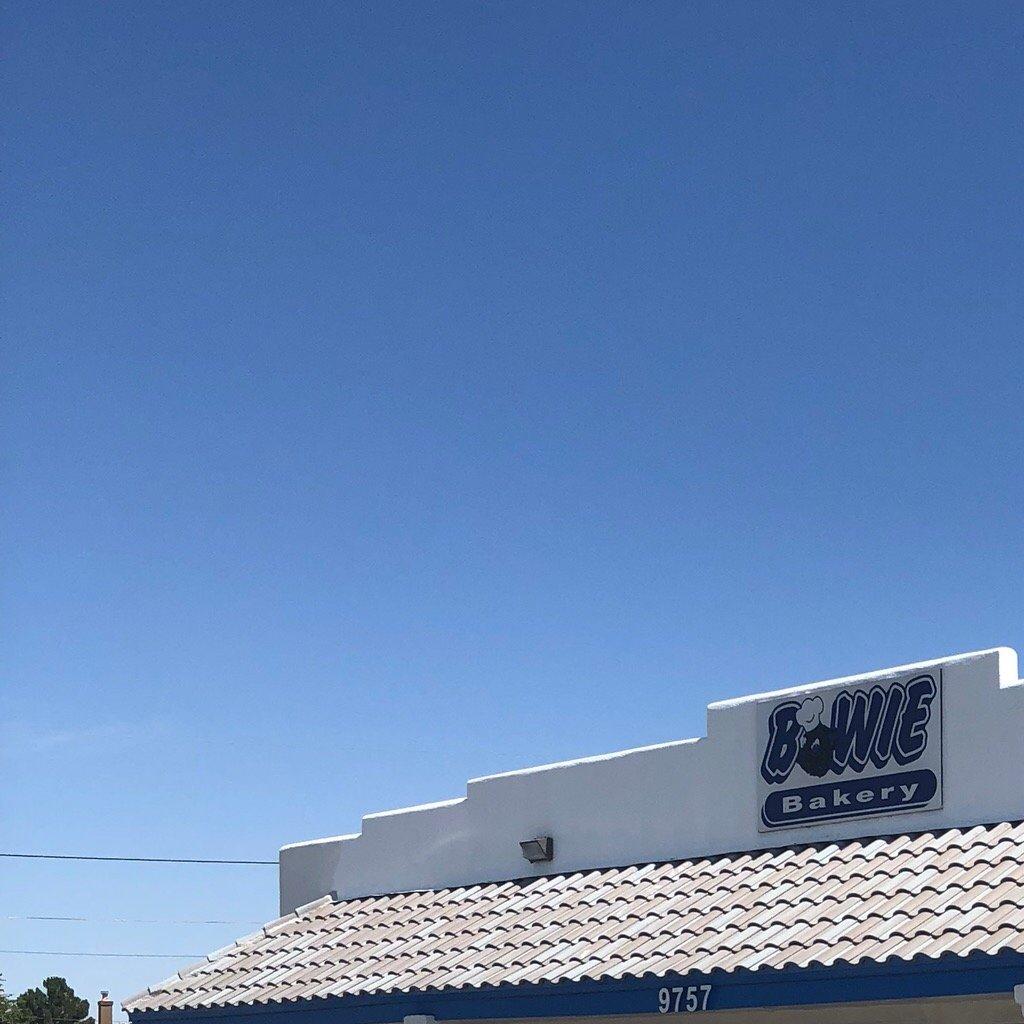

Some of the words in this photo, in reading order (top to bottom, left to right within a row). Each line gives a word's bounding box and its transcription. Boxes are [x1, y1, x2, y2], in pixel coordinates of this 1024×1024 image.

[761, 674, 937, 785] BWIE
[782, 783, 919, 814] Bakery
[658, 984, 712, 1013] 9757
